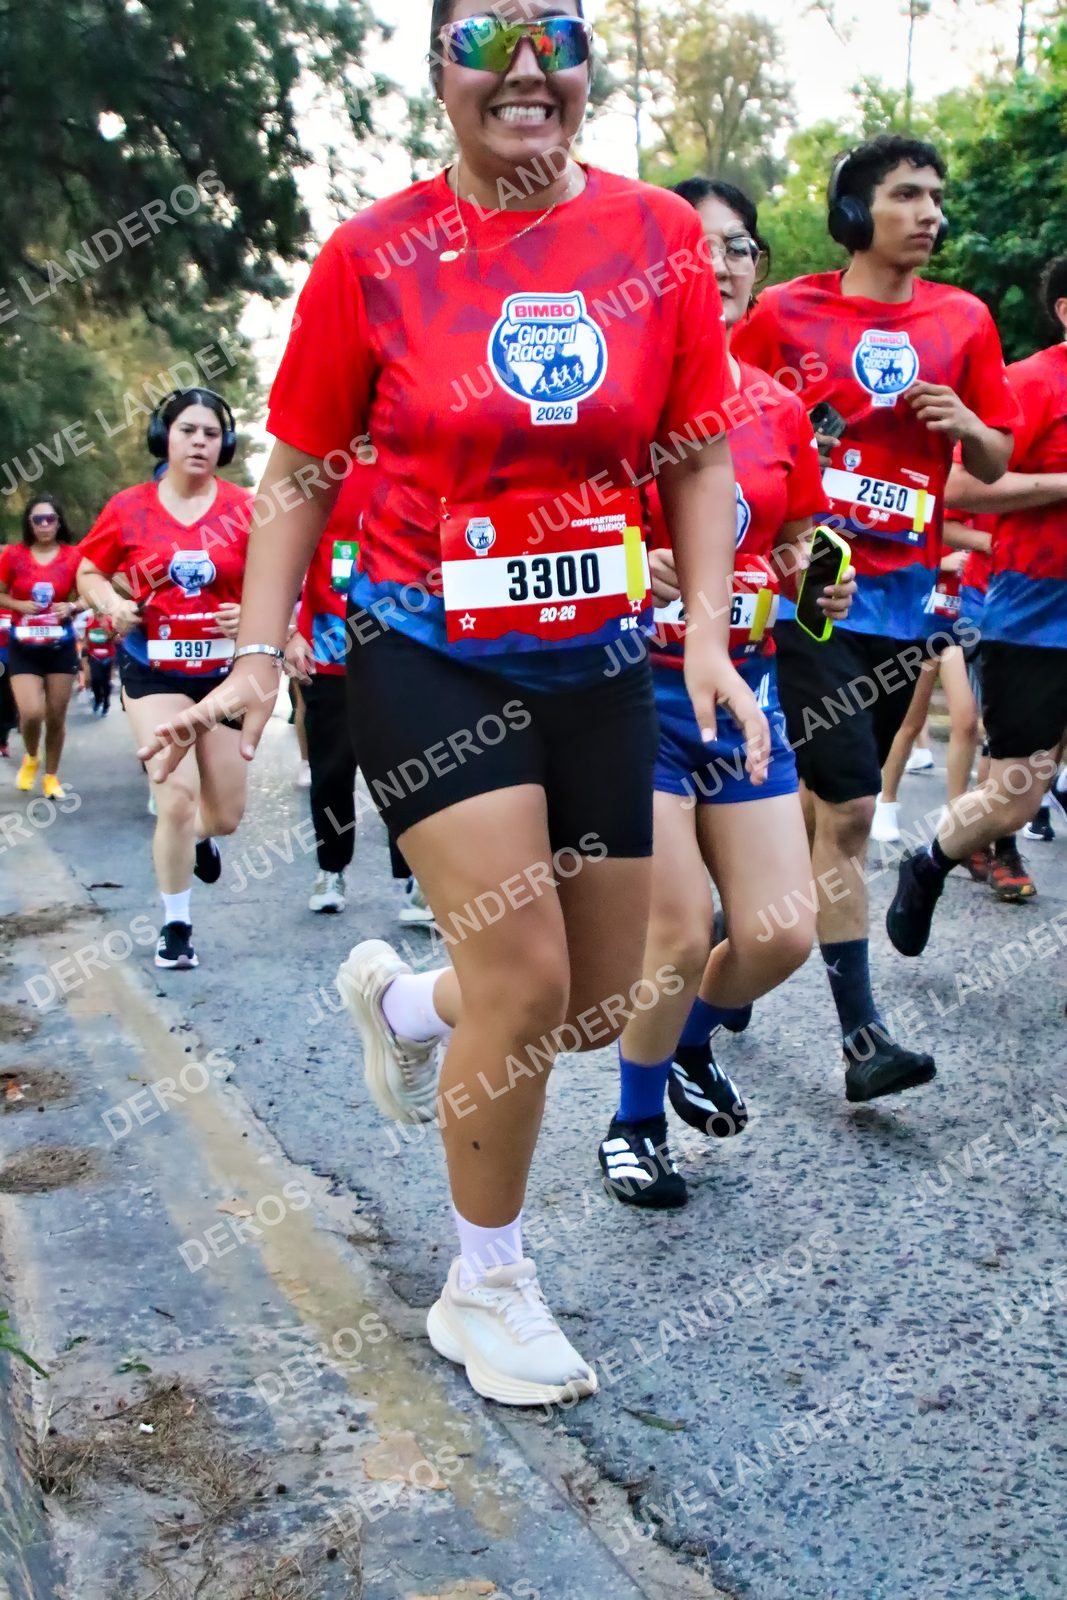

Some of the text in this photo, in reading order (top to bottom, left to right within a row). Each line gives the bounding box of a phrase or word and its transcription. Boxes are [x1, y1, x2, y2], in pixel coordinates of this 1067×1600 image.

[515, 304, 575, 317] BIMBO
[518, 324, 575, 345] Global
[870, 336, 903, 345] BIMBO
[508, 342, 555, 361] Race
[871, 347, 903, 360] Global
[864, 357, 891, 369] Race
[536, 406, 573, 421] 2026
[856, 478, 908, 511] 2550
[507, 552, 600, 601] 3300
[620, 616, 639, 631] 5K
[174, 641, 212, 658] 3397
